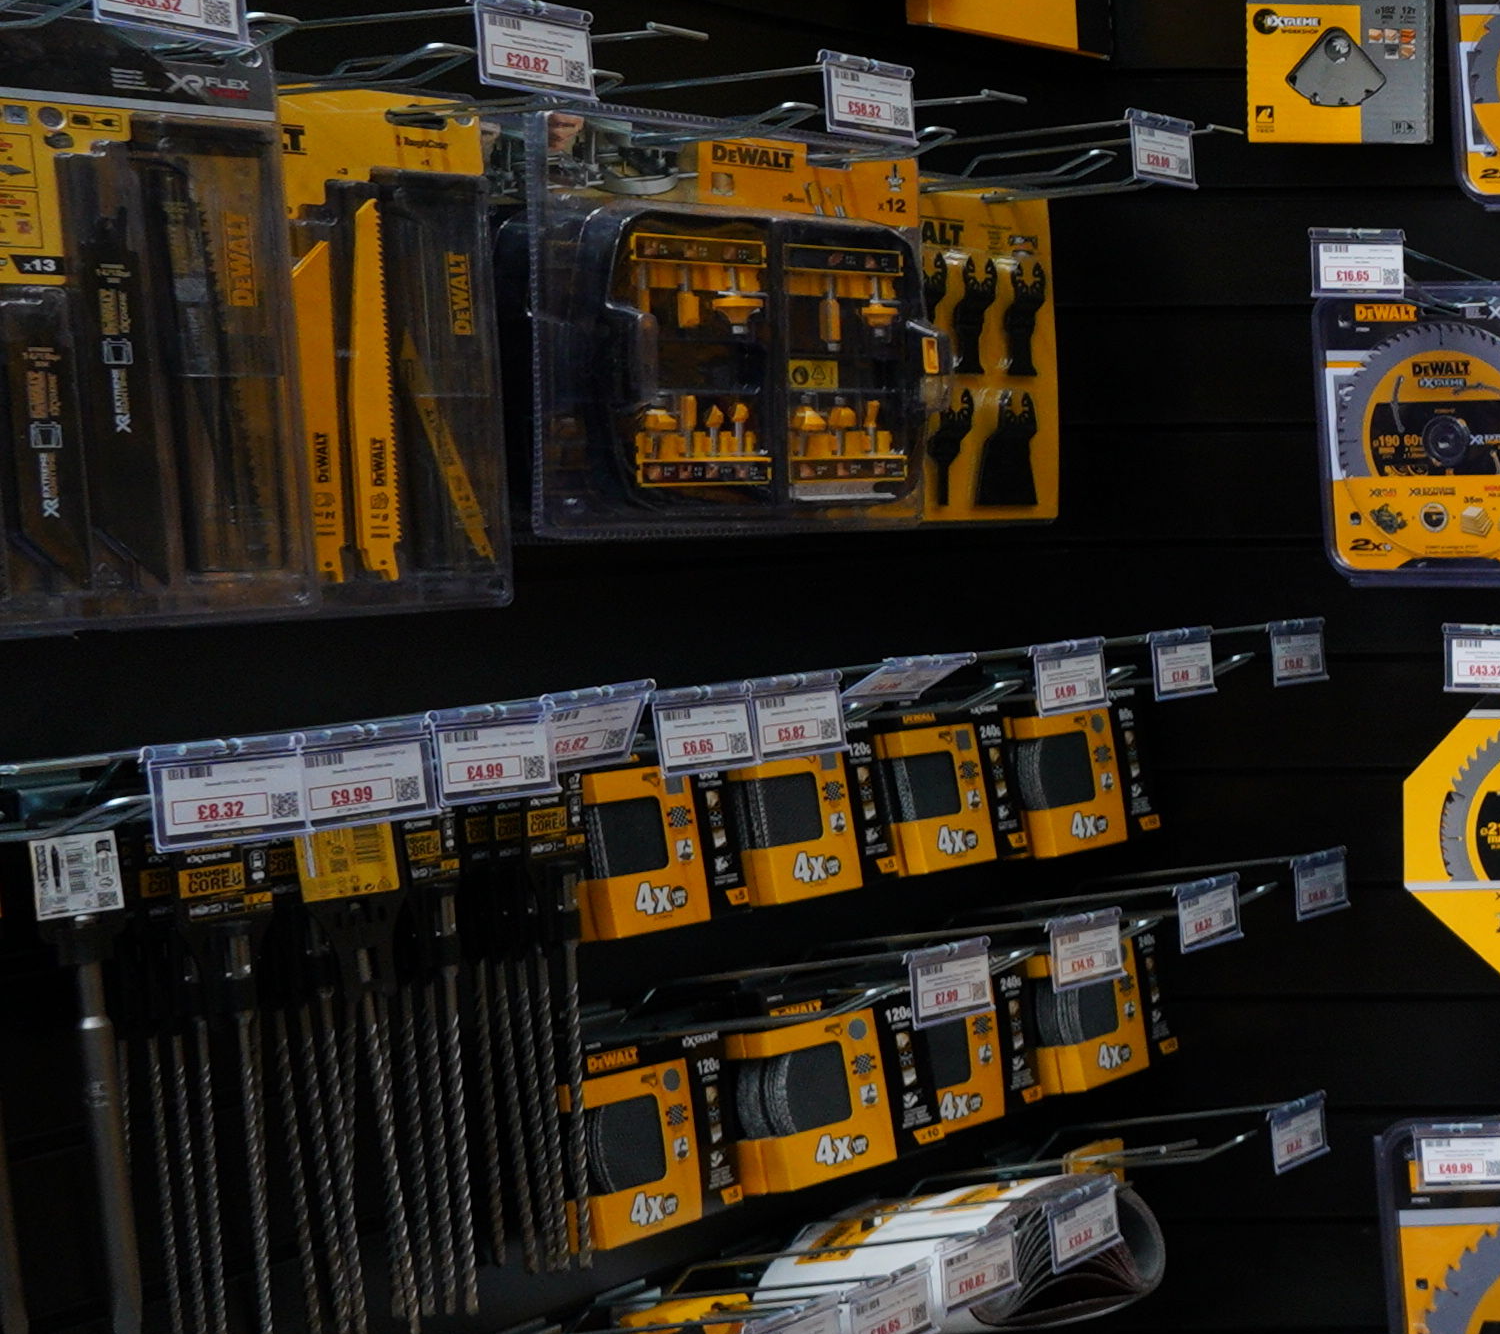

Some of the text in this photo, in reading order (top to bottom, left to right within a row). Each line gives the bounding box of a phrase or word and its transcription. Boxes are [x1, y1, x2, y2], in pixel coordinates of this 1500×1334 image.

[506, 53, 548, 73] £20.82
[848, 101, 882, 118] £58.32
[712, 144, 794, 173] DEWALT
[1336, 271, 1369, 282] £16.65
[1468, 665, 1500, 676] £43.32
[683, 739, 714, 755] £6.65
[467, 763, 504, 780] £4.99
[331, 787, 373, 807] £9.99
[197, 801, 243, 822] £8.32
